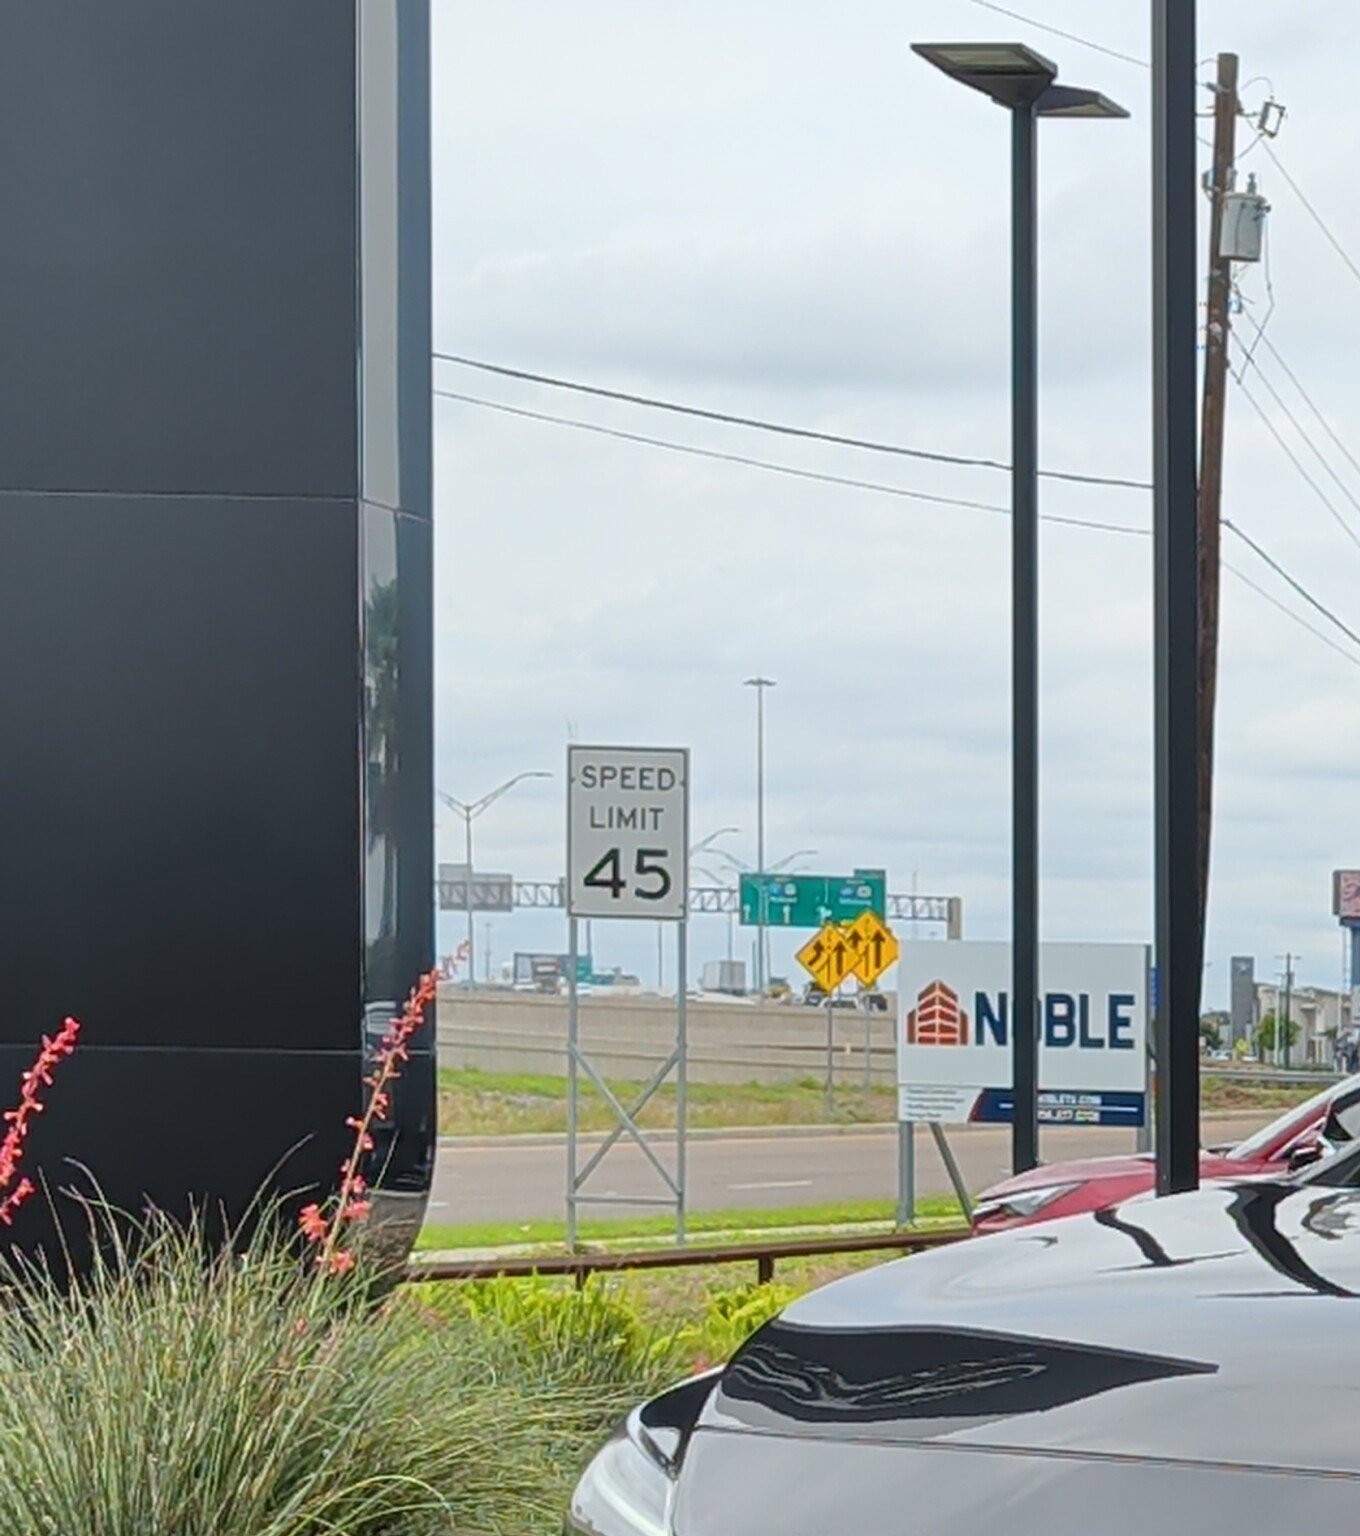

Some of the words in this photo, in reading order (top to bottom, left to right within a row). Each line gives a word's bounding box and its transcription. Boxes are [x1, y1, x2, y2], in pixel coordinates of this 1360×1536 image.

[581, 765, 676, 791] SPEED
[590, 805, 664, 831] LIMIT
[583, 847, 672, 900] 45
[975, 991, 1136, 1049] NBLE
